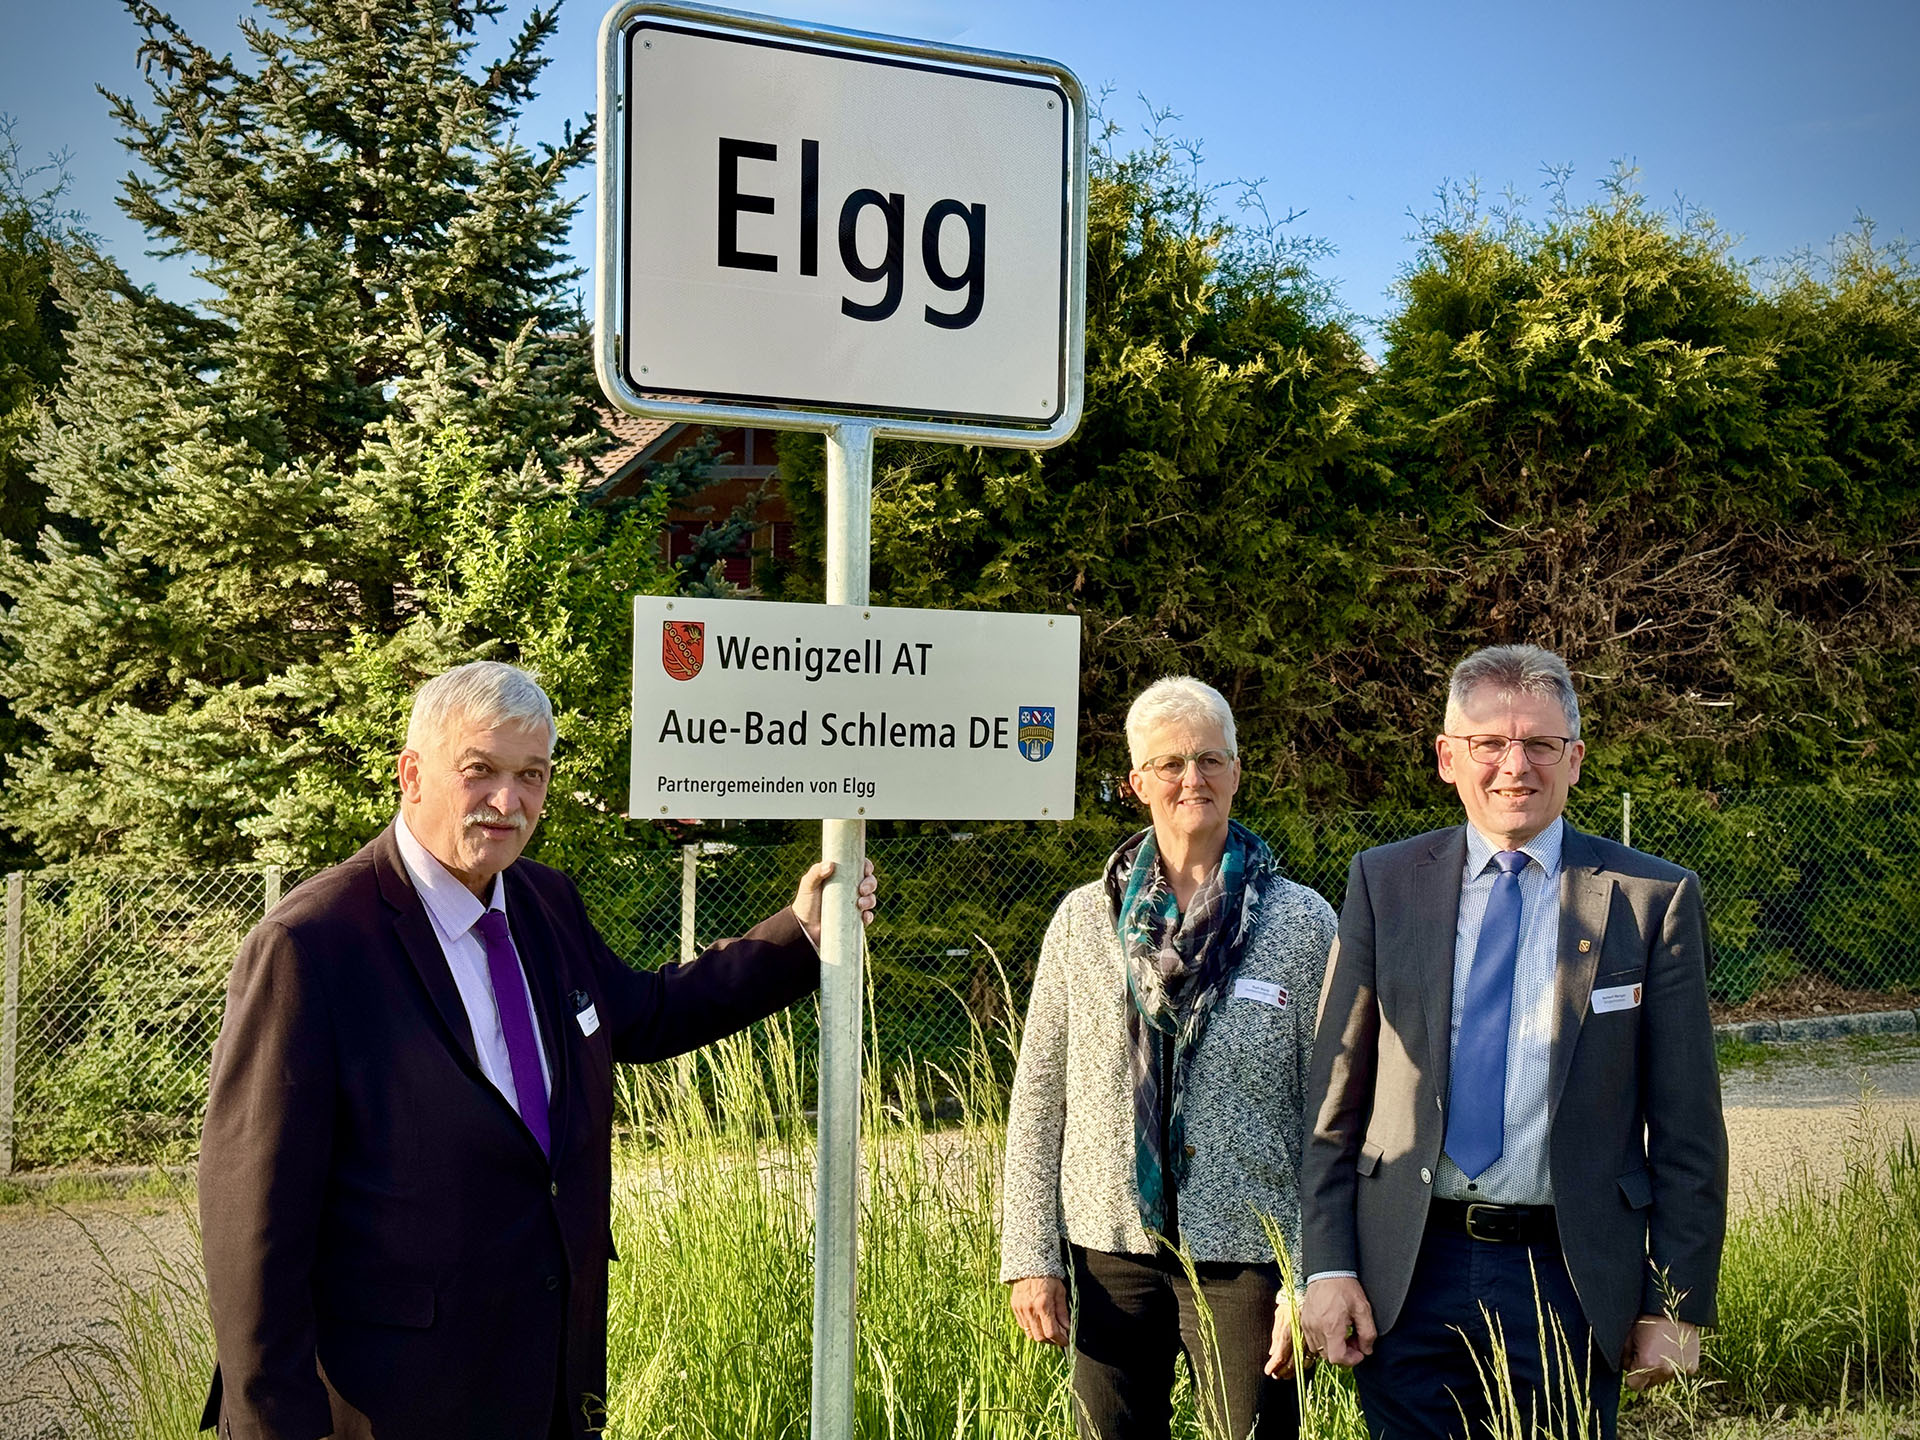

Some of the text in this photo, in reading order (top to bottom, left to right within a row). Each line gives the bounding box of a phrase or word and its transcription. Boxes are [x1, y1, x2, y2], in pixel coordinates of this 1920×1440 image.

[718, 137, 986, 329] Elgg
[716, 636, 933, 681] Wenigzell AT
[658, 710, 1009, 749] Aue-Bad Schlema DE
[657, 776, 876, 798] Partnergemeinden von Elgg
